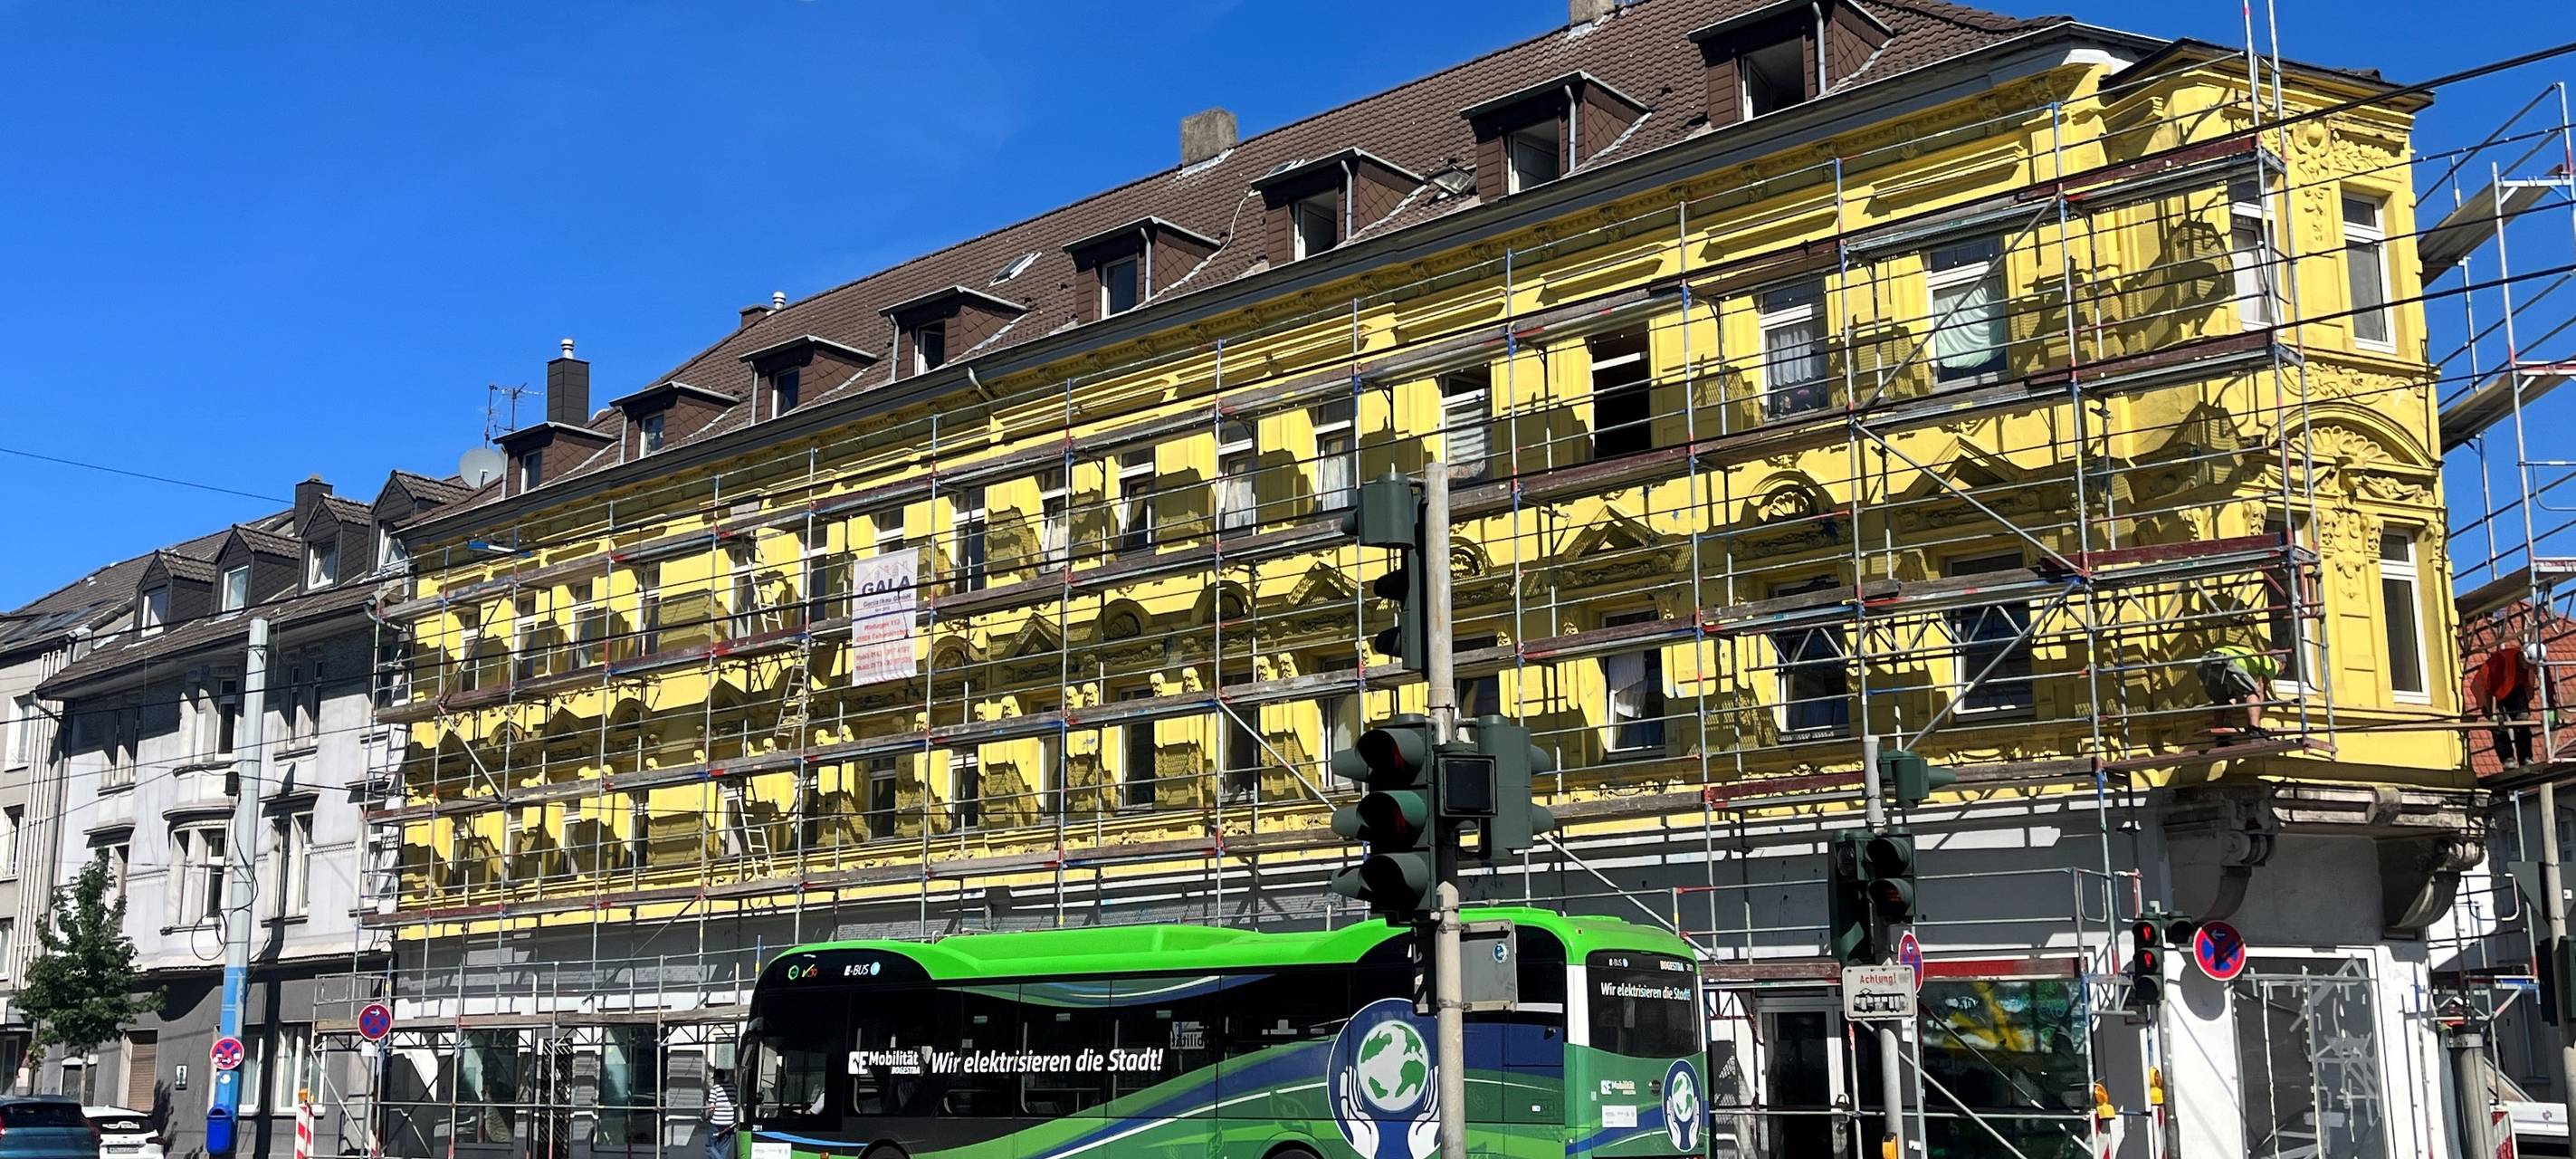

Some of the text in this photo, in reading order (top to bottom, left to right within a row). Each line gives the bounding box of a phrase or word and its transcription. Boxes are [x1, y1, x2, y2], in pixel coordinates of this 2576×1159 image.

[862, 575, 911, 595] GALA
[844, 963, 870, 976] E-BUS
[1859, 972, 1896, 985] Achtung!
[1600, 982, 1617, 996] Wir
[1617, 982, 1662, 999] elektrisieren
[1662, 985, 1673, 1000] die
[868, 1050, 919, 1066] Mobilität
[931, 1047, 1164, 1074] Wir elektrisieren die Stadt!
